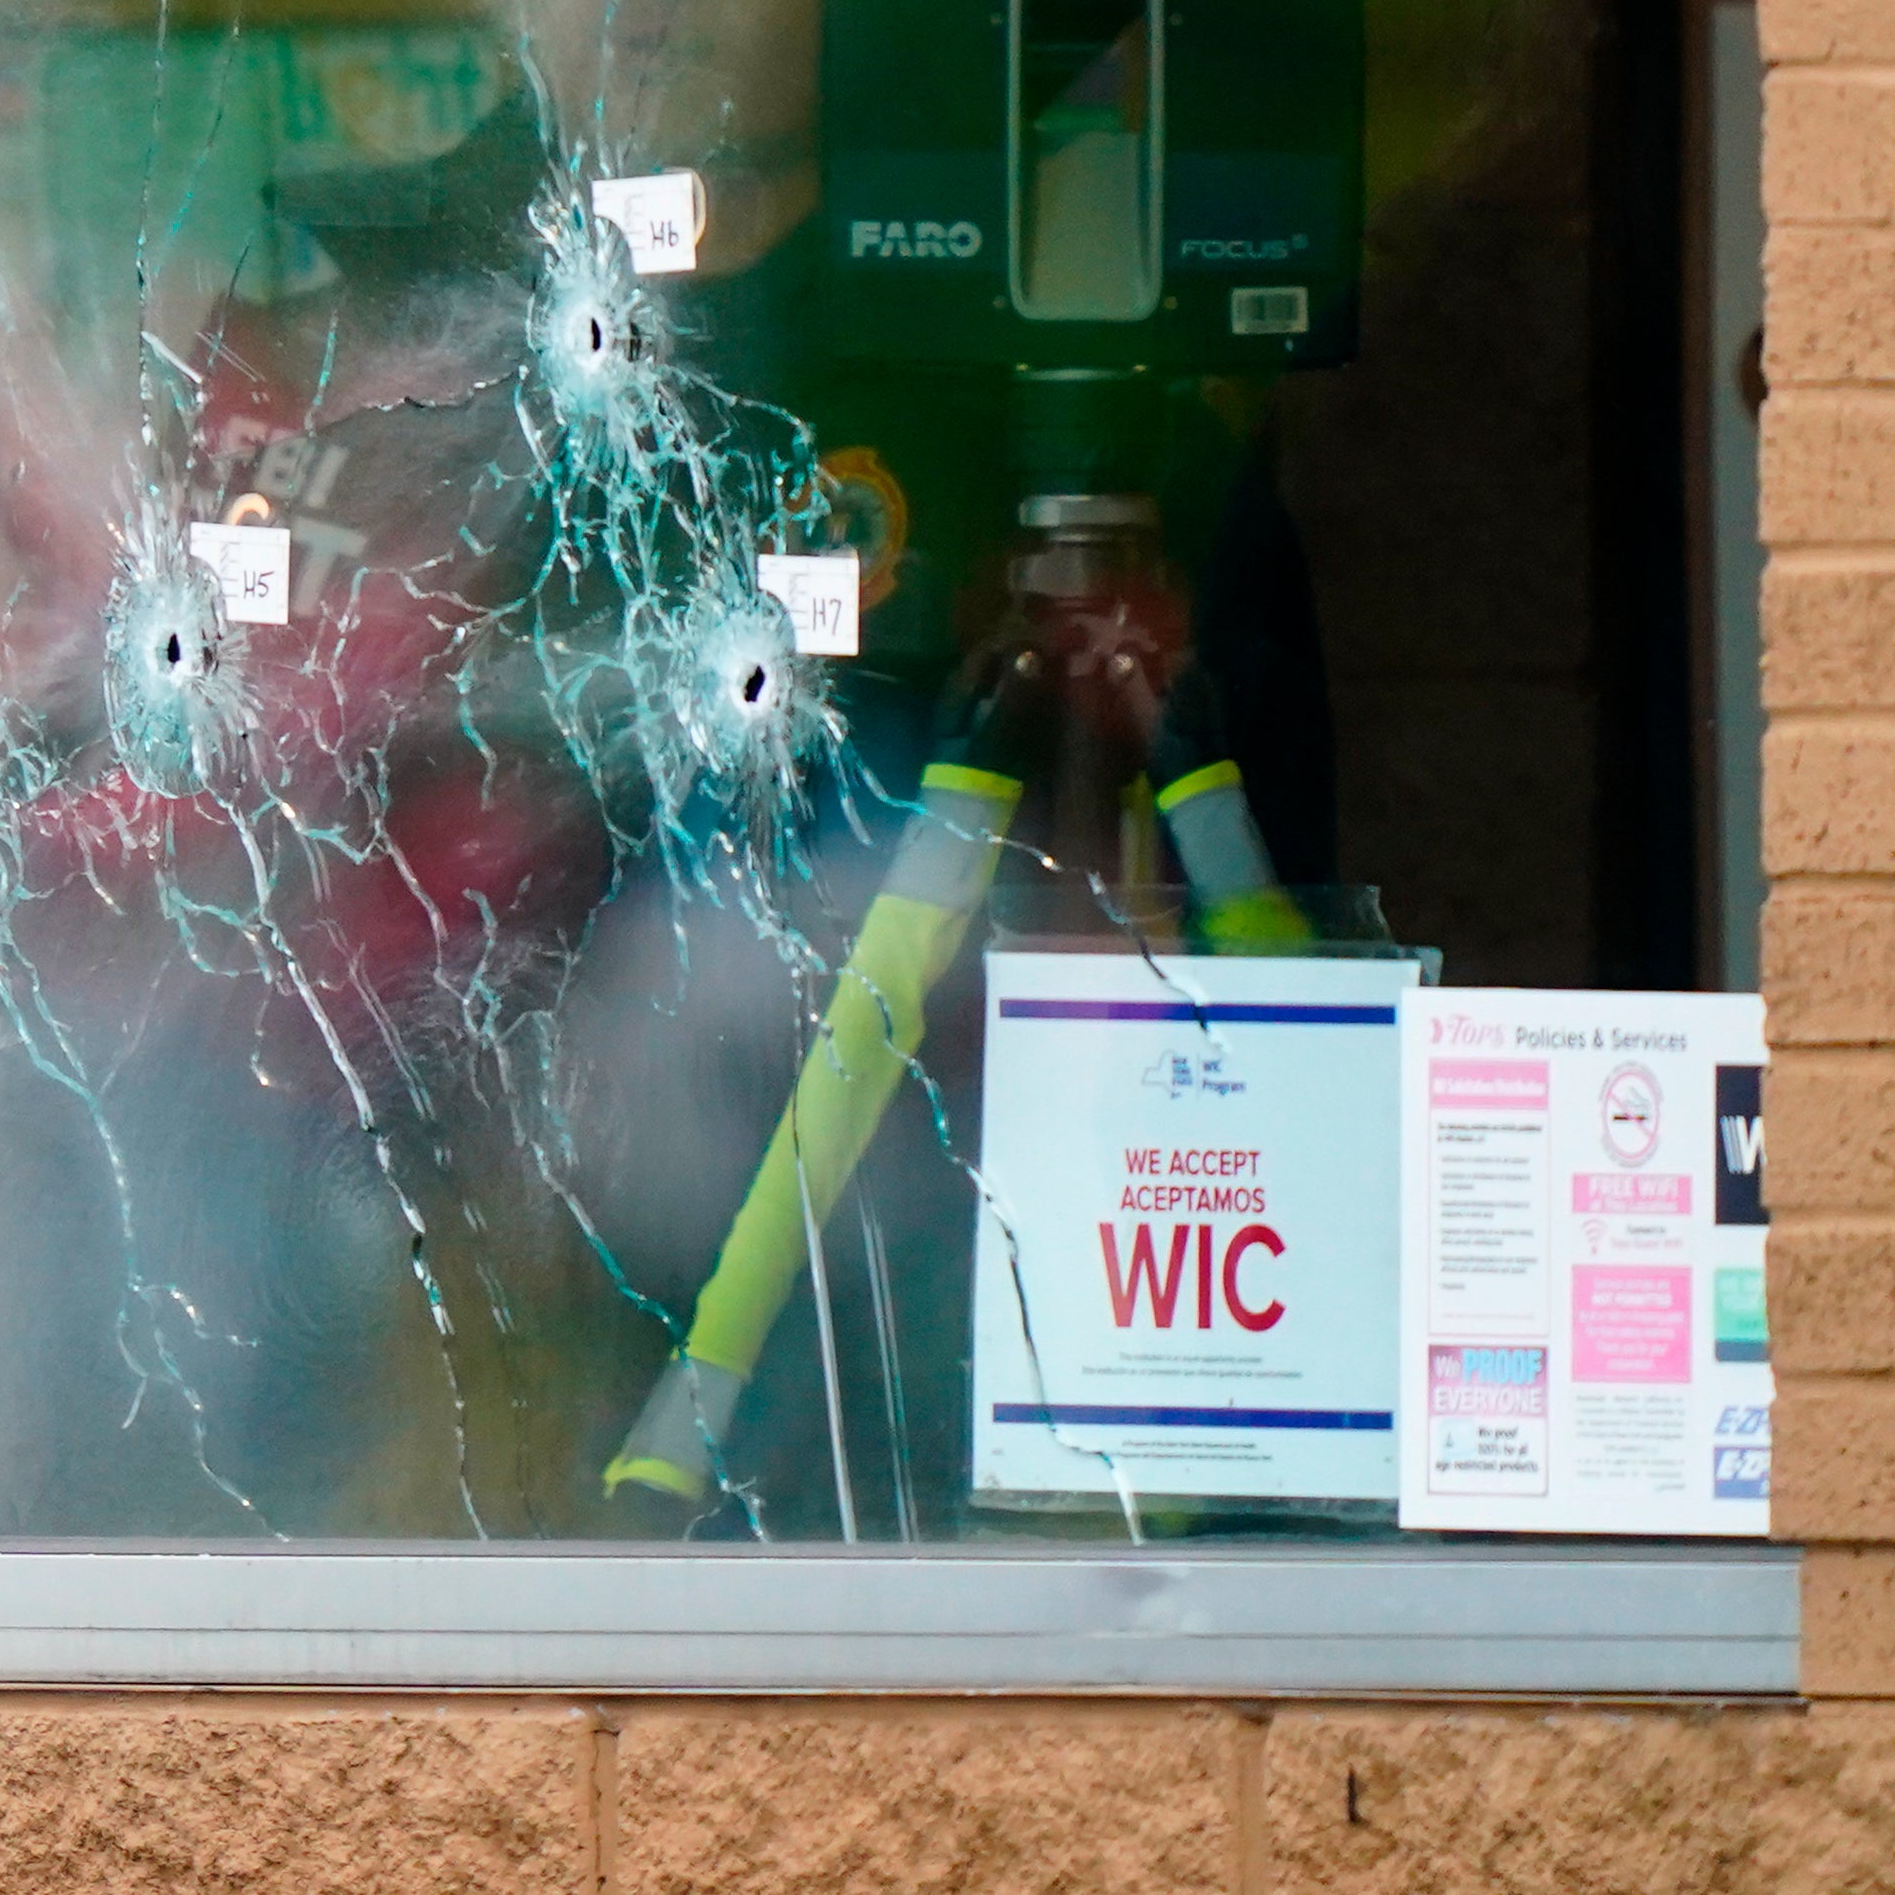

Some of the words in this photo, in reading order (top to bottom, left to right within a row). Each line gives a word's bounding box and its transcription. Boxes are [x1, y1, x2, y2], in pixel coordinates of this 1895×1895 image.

[851, 221, 982, 258] FARO
[1181, 239, 1288, 259] FOCUS
[243, 569, 275, 600] H5
[813, 597, 842, 637] H7
[1515, 1026, 1586, 1049] Policies
[1592, 1027, 1604, 1049] &
[1610, 1027, 1688, 1051] Services
[1125, 1148, 1162, 1175] WE
[1168, 1149, 1261, 1177] ACCEPT
[1120, 1185, 1266, 1213] ACEPTAMOS
[1098, 1222, 1286, 1332] WIC
[1463, 1348, 1543, 1385] PROOF
[1433, 1386, 1543, 1413] EVERYONE
